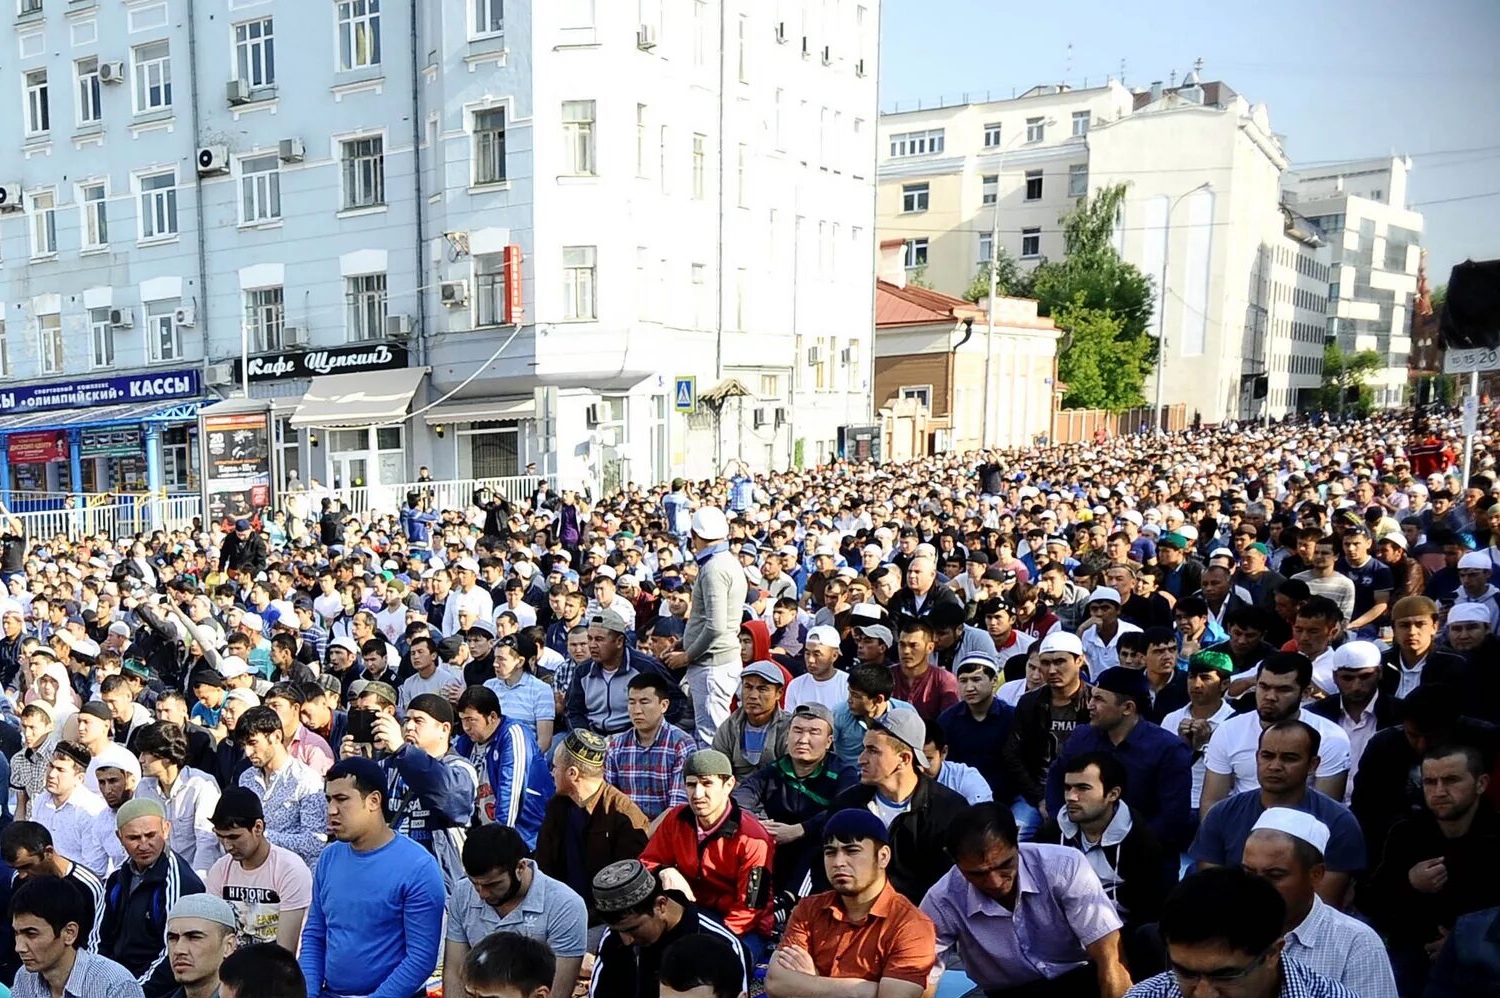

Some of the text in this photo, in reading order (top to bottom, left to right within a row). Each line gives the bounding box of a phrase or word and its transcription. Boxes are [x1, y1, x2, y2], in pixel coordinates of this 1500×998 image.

[1479, 351, 1497, 364] 20
[248, 356, 295, 377] Кафе
[129, 375, 190, 397] КАССЫ
[229, 887, 271, 901] HISTORIC
